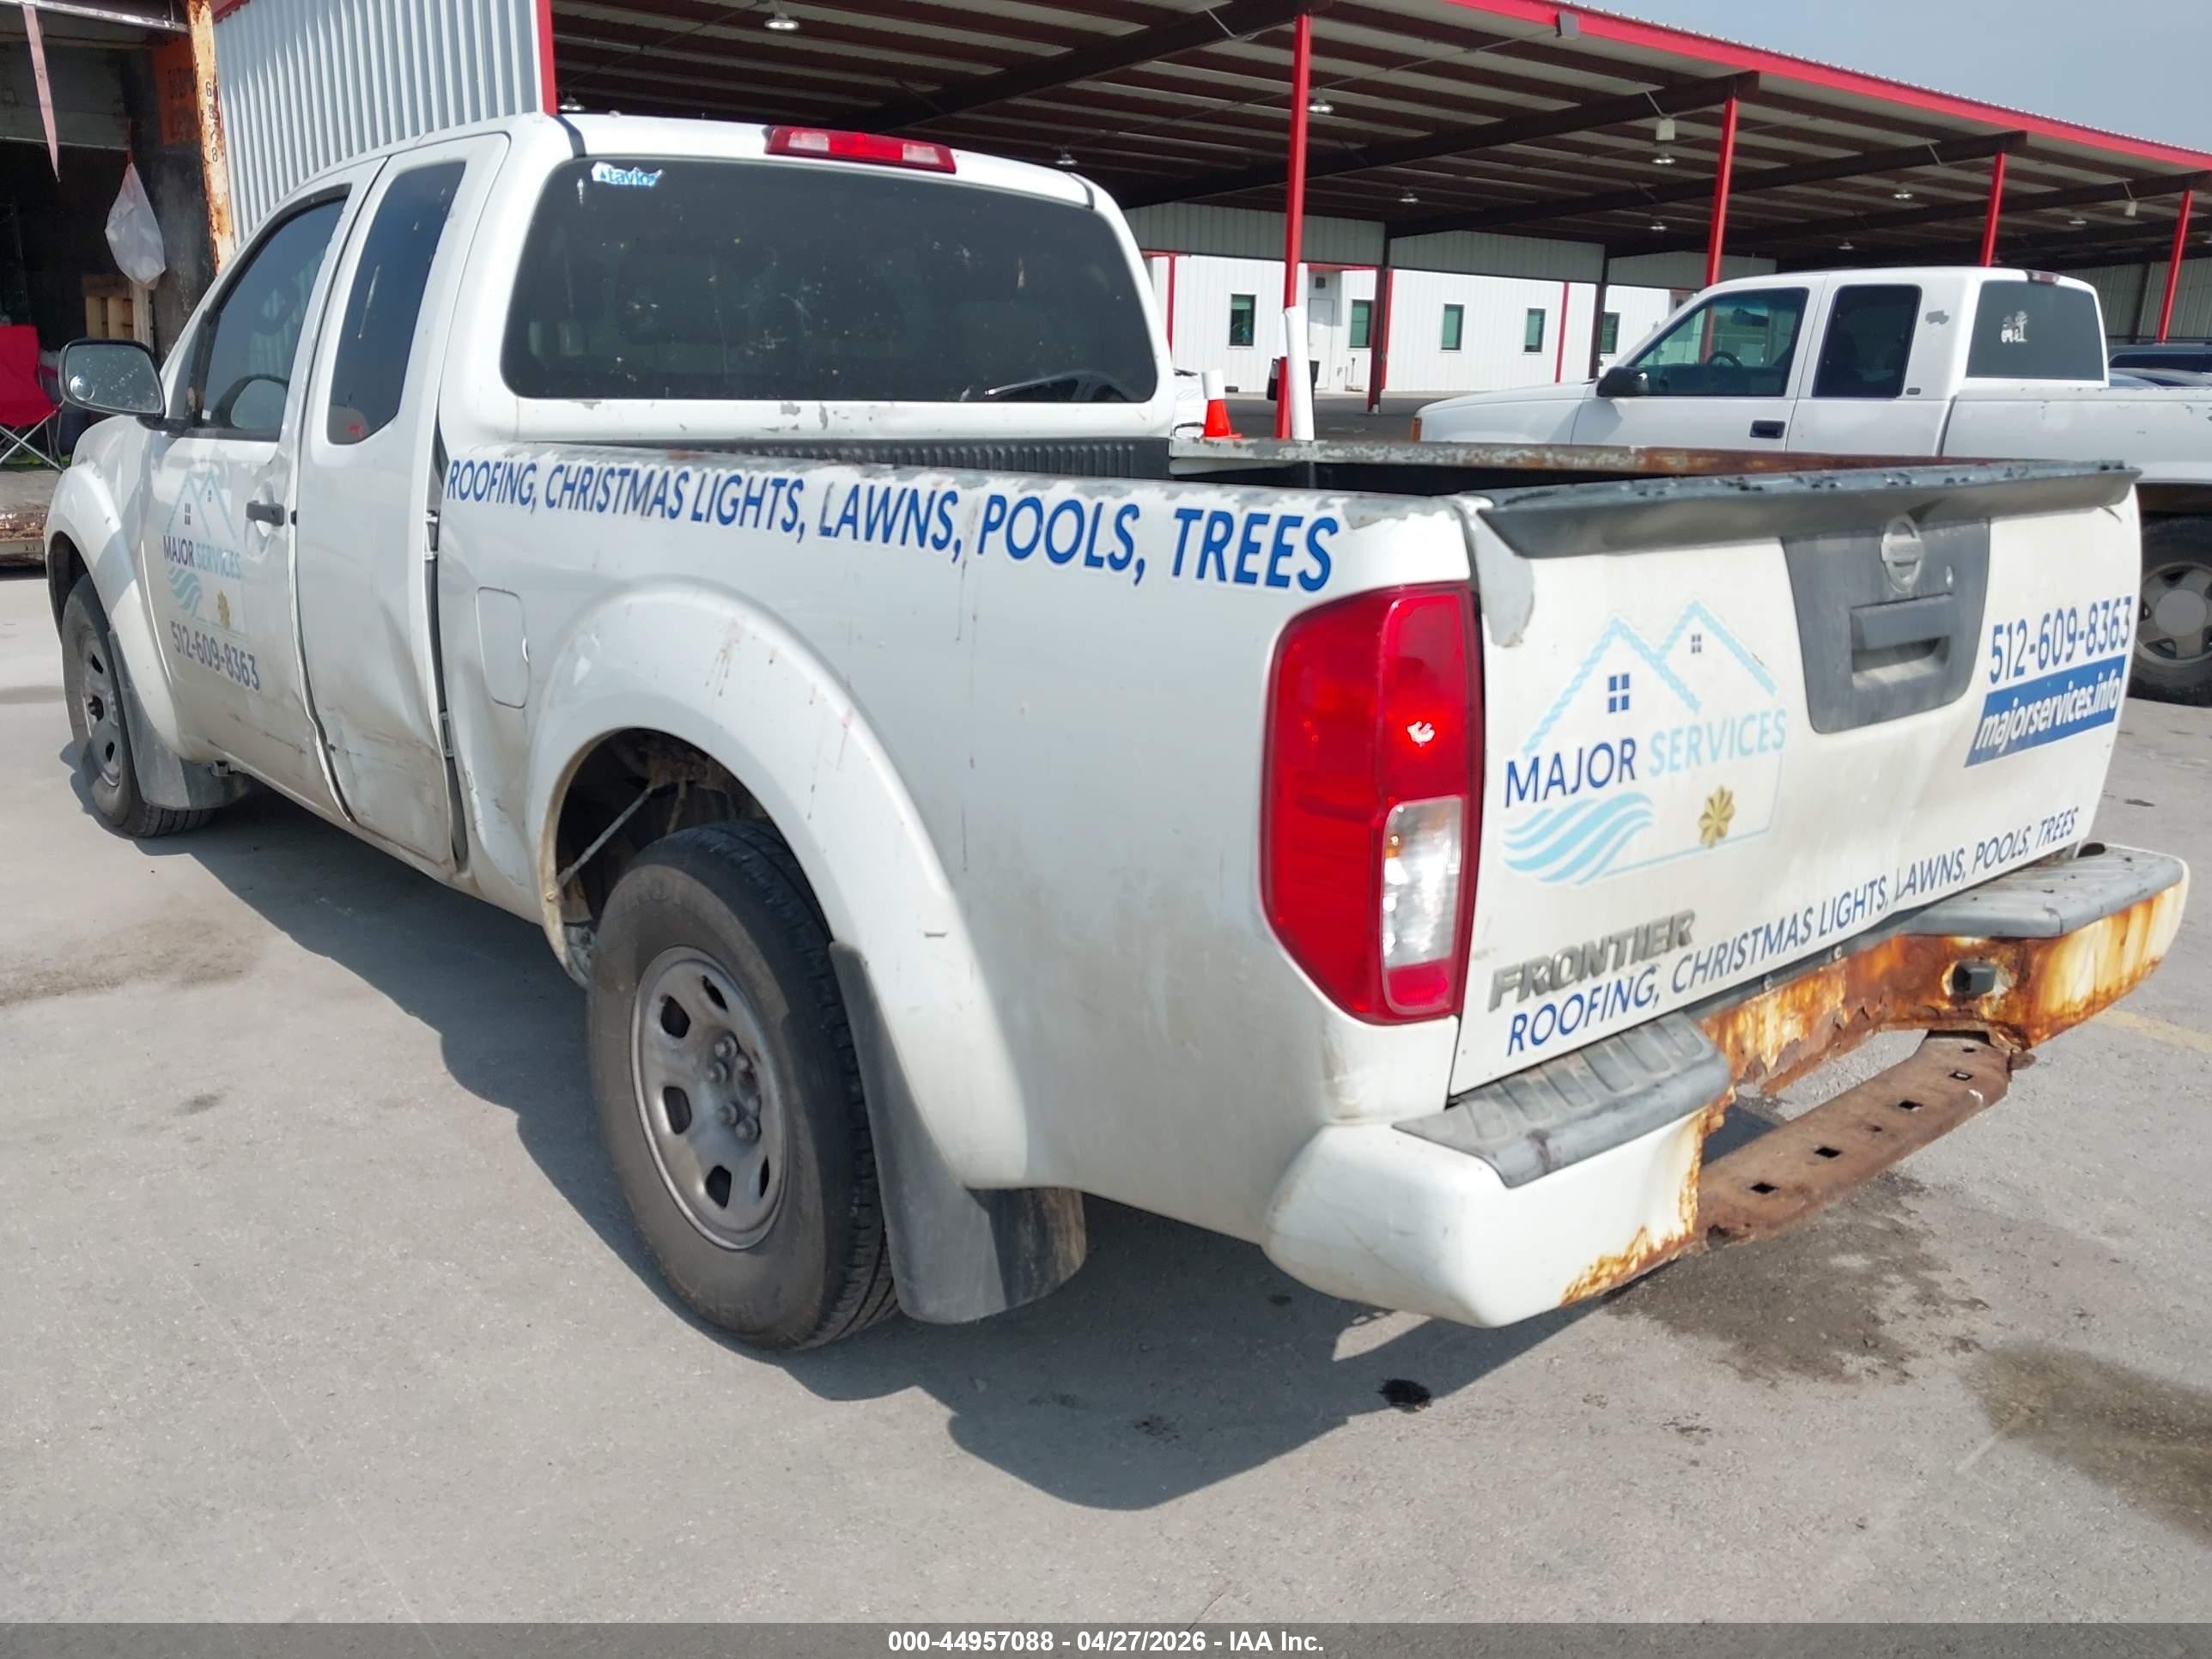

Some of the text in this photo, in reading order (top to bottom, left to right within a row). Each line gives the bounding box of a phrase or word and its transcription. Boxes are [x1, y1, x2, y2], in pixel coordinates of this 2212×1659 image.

[163, 535, 241, 580] MAJOR SERVICES
[447, 459, 1339, 592] ROOFING, CHRISTMAS LIGHTS, LAWNS, POOLS, TREES
[169, 620, 261, 692] 512-609-8363
[1989, 595, 2133, 685] 512-609-8363
[1504, 708, 1787, 809] MAJOR SERVICES
[1975, 668, 2123, 754] majorservices.info
[1488, 909, 1696, 1013] FRONTIER
[1507, 805, 2079, 1057] ROOFING, CHRISTMAS LIGHTS, LAWNS, POOLS, TREES
